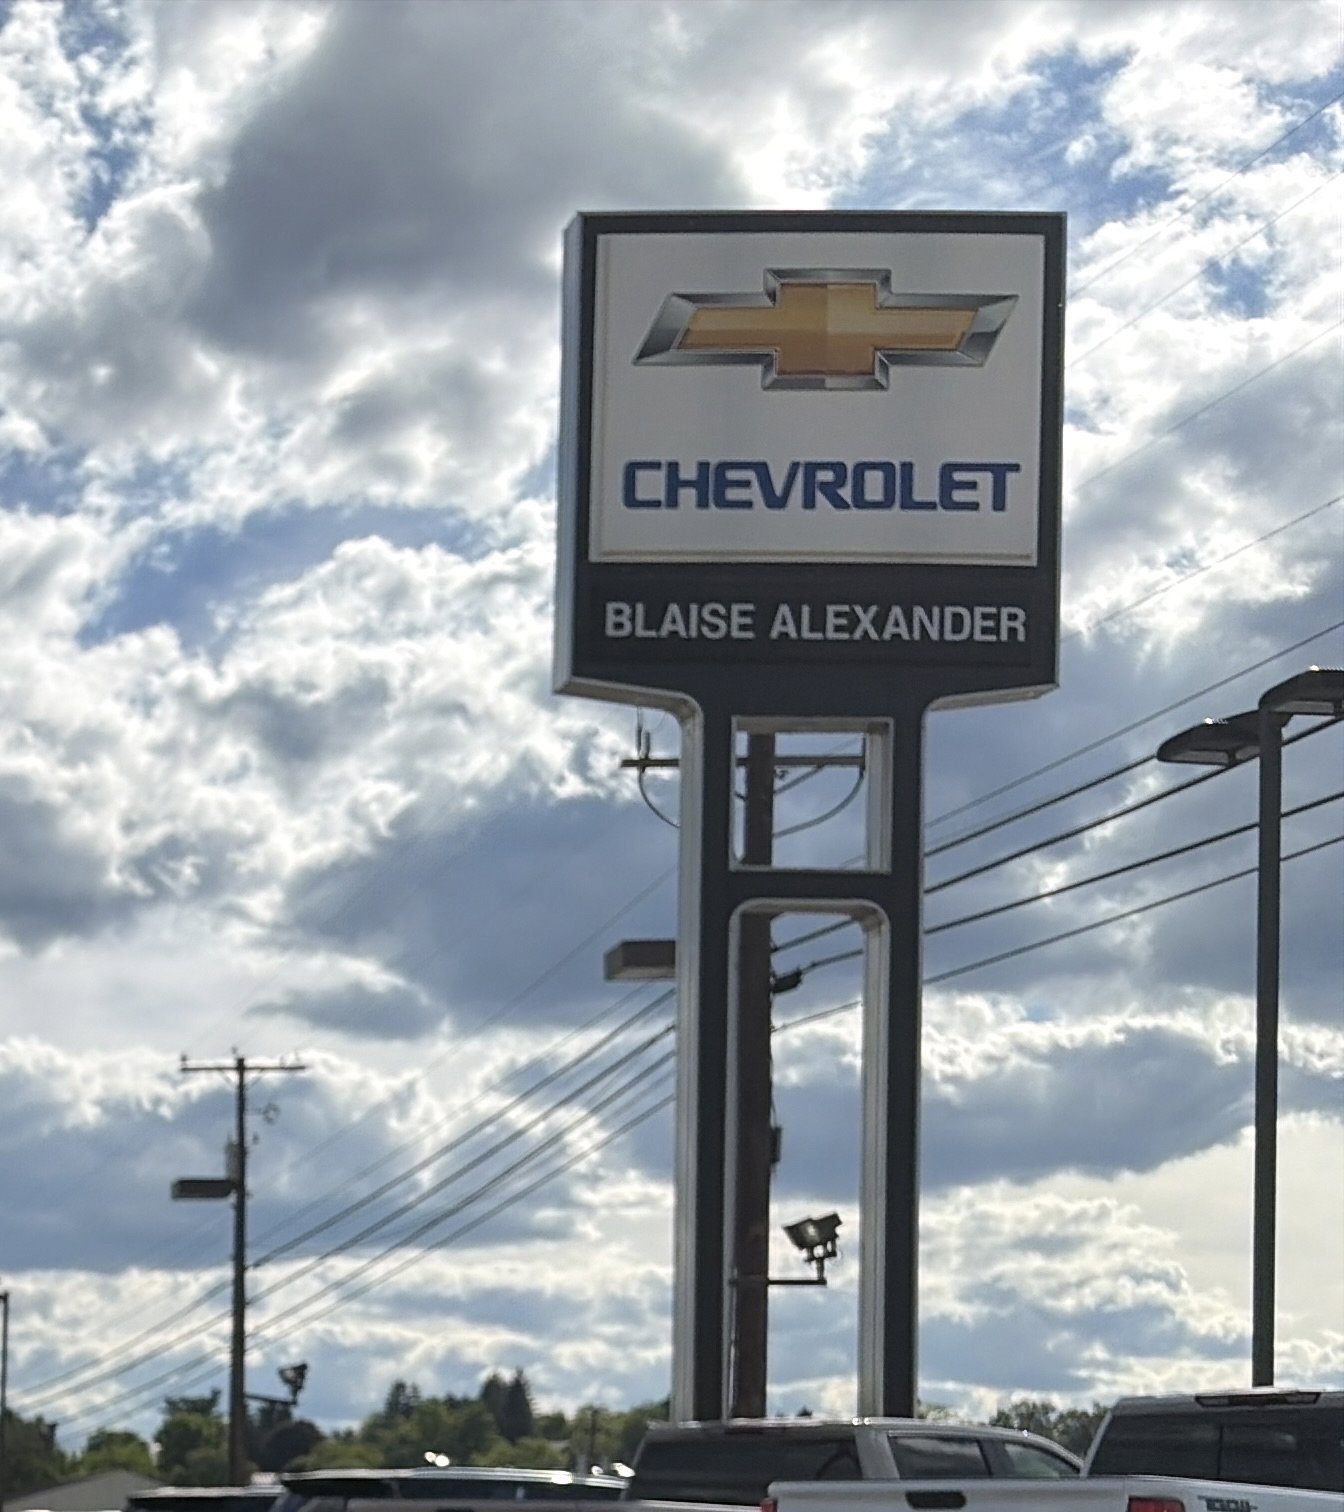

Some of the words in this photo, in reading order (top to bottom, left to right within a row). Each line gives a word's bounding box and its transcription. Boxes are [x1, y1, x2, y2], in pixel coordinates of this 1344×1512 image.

[623, 461, 1021, 512] CHEVROLET
[604, 602, 756, 640] BLAISE
[769, 603, 1027, 643] ALEXANDER
